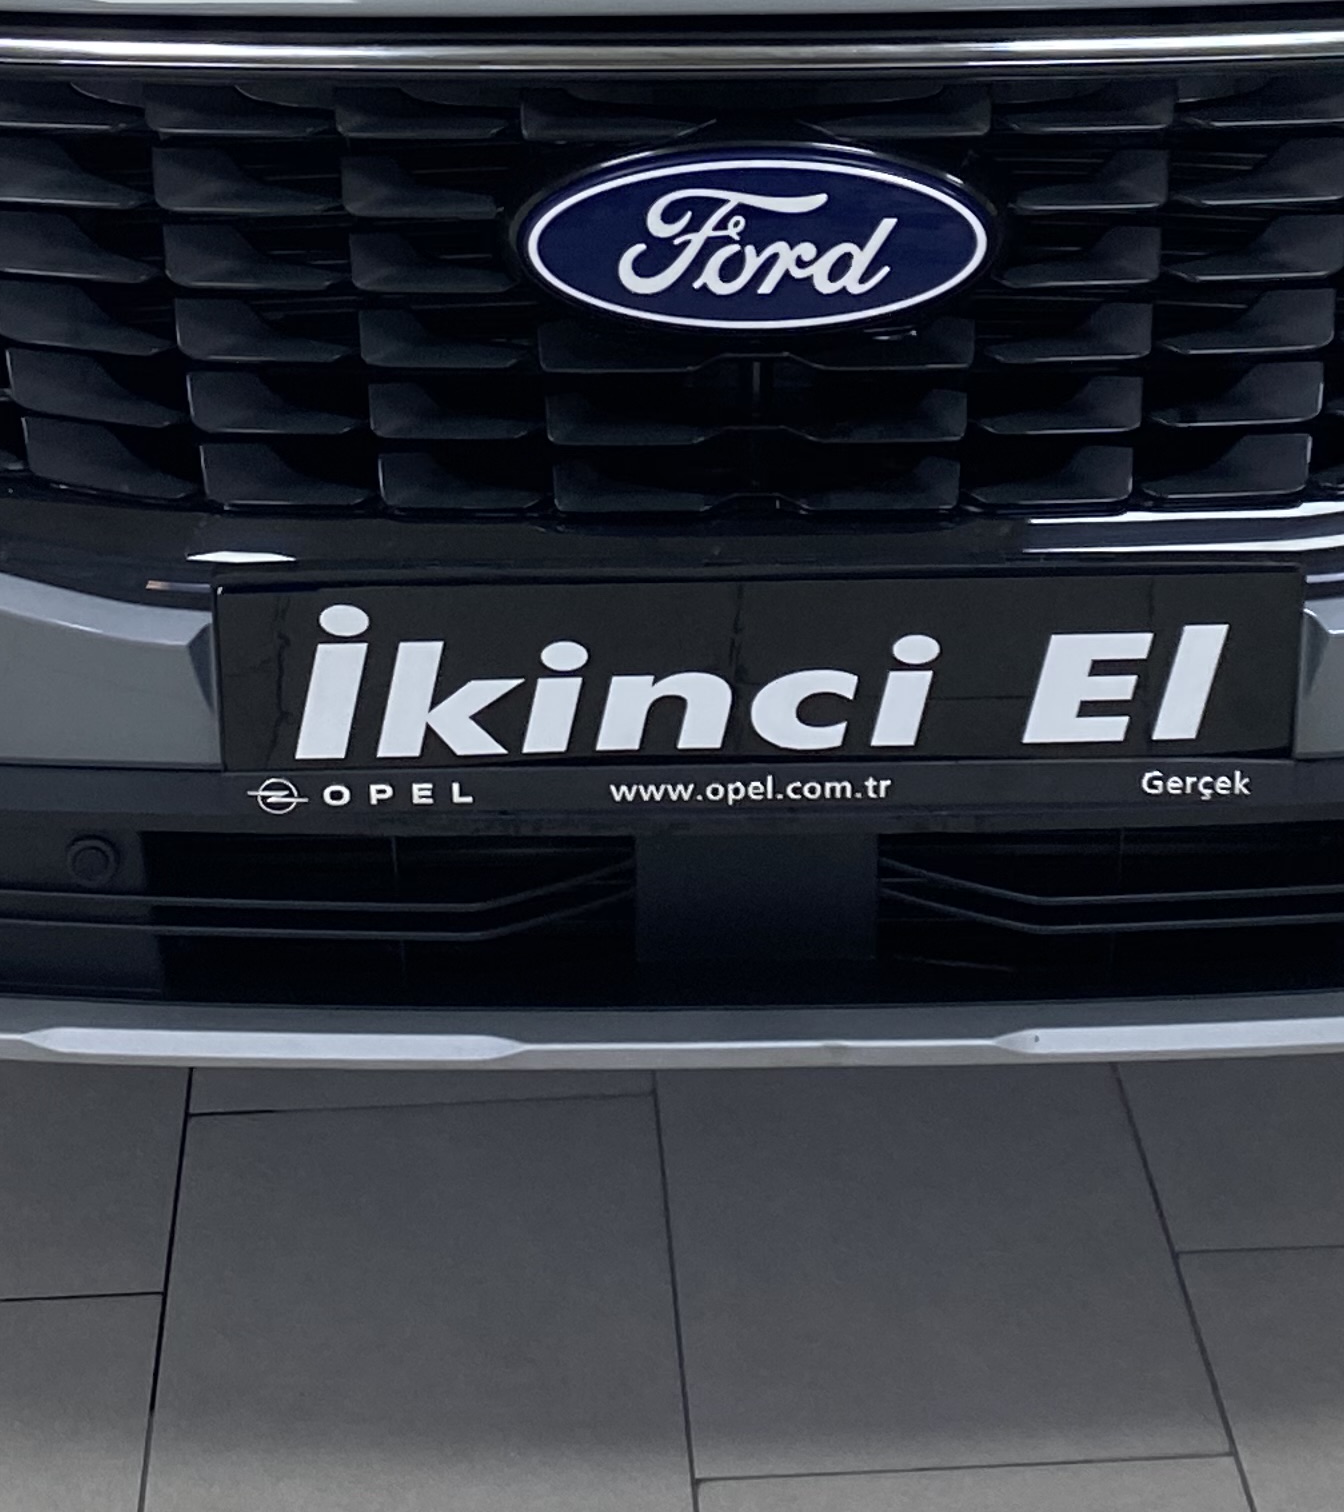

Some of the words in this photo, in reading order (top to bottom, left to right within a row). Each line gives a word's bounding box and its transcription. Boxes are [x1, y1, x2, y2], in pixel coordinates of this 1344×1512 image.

[617, 188, 899, 296] Ford
[294, 604, 941, 760] İkinci
[1021, 623, 1230, 744] El
[323, 782, 474, 806] OPEL
[609, 774, 892, 806] www.opel.com.tr
[1141, 769, 1252, 801] Gerçek
